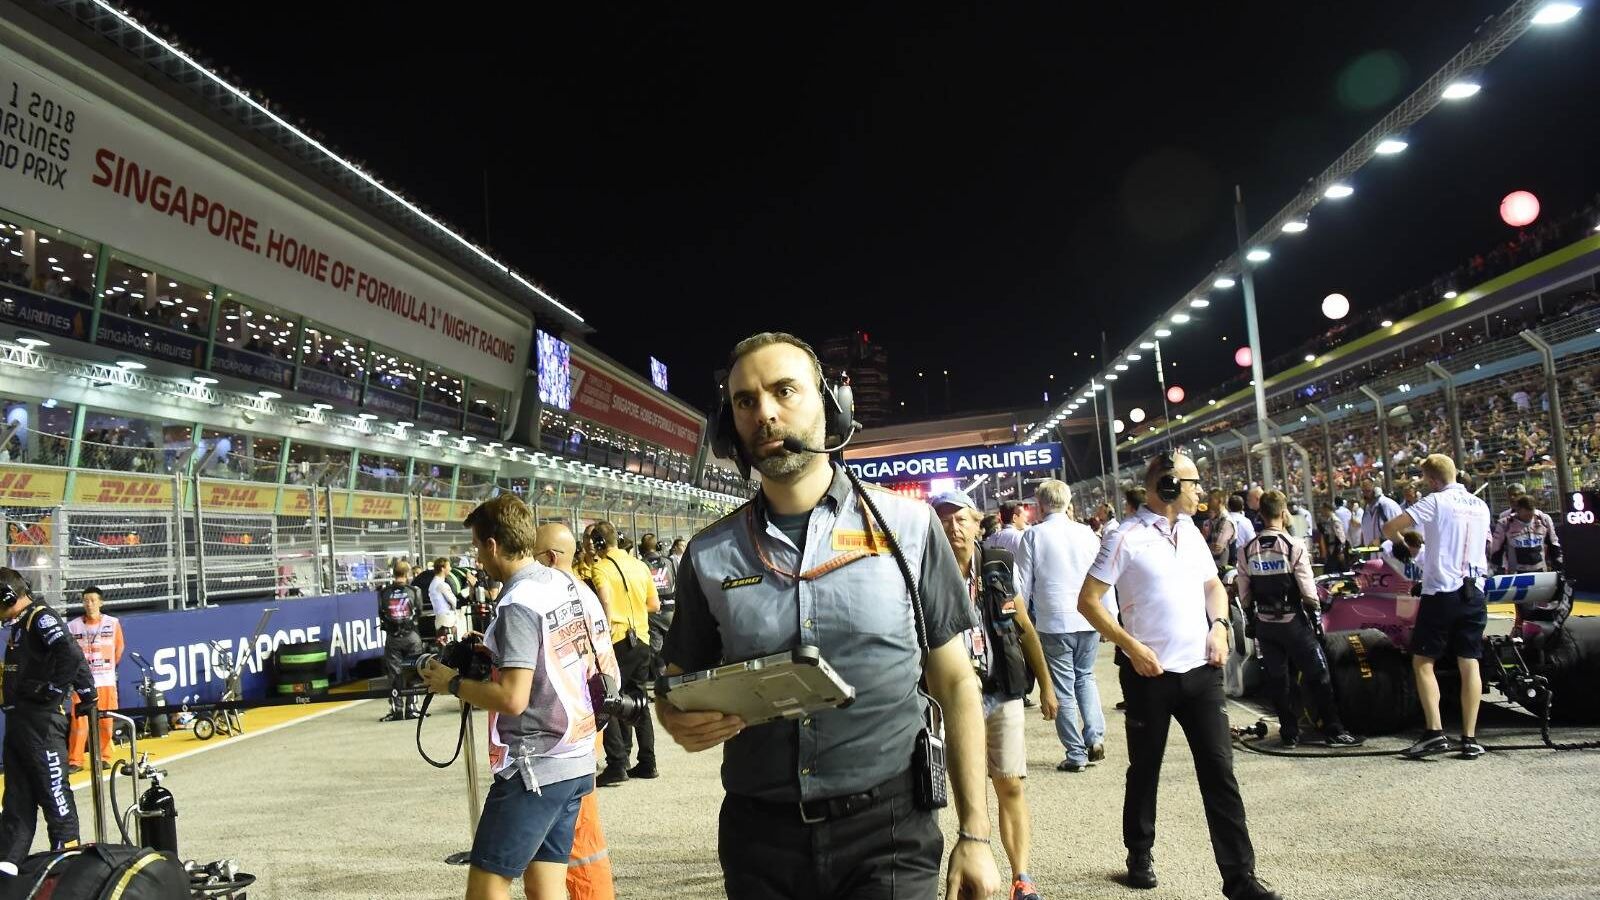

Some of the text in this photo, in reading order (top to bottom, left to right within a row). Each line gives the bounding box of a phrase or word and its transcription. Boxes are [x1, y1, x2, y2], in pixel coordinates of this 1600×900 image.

[9, 82, 75, 133] 1 2018
[22, 152, 68, 190] PRIX
[92, 147, 261, 254] SINGAPORE.
[266, 228, 329, 283] HOME
[330, 261, 355, 293] OF
[356, 271, 428, 328] FORMULA
[441, 313, 479, 347] NIGHT
[479, 328, 516, 364] RACING
[17, 307, 71, 331] AIRLINES
[97, 326, 193, 361] SINGAPORE AIRLINES
[848, 448, 1052, 479] NGAPORE AIRLINES
[97, 479, 163, 504] DHL
[209, 486, 258, 508] DHL
[361, 498, 393, 514] DHL
[1566, 510, 1595, 525] GRO
[1262, 559, 1285, 571] BWT
[329, 616, 387, 657] AIRLI
[46, 750, 70, 817] RENAULT
